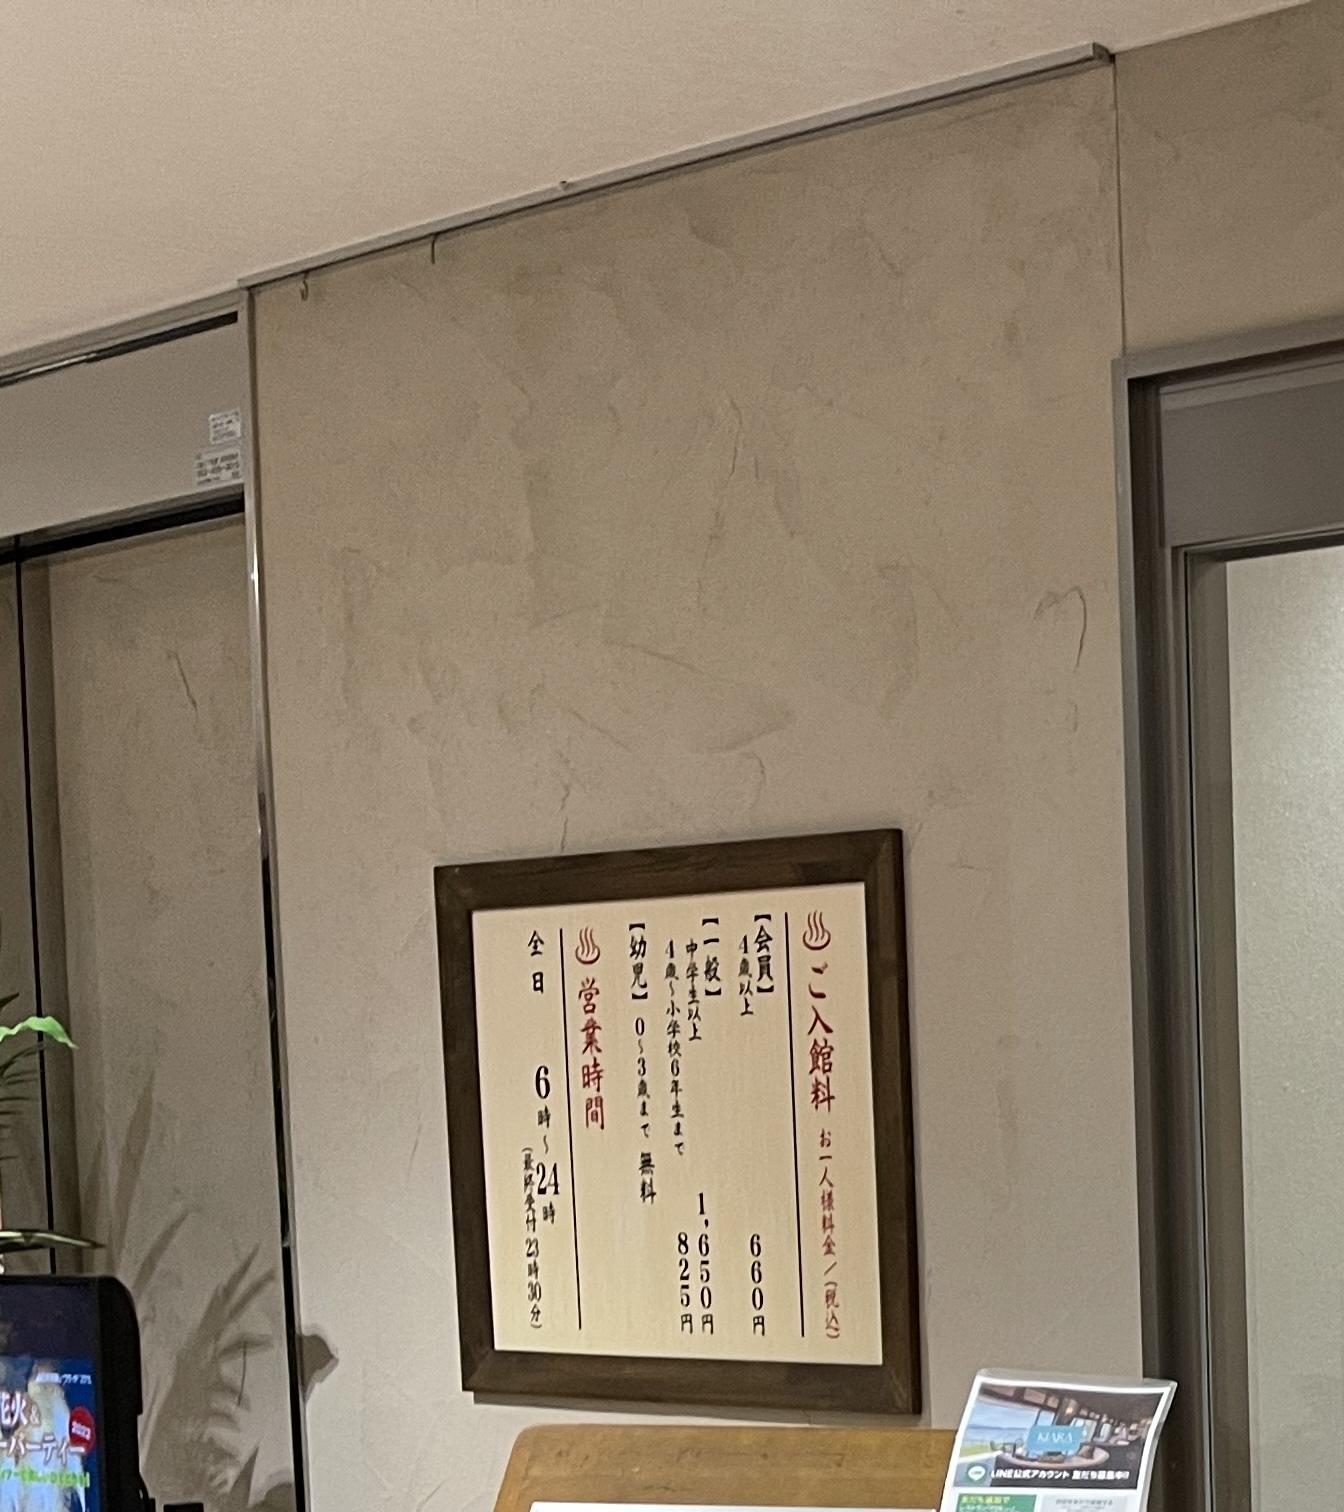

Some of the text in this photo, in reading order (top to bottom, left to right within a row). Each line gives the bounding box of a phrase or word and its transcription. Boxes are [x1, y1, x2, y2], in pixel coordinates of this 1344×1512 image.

[685, 939, 702, 1041] 中学生以上
[807, 964, 836, 1112] ご入館料
[577, 978, 605, 1131] 営業時間
[639, 1152, 656, 1204] 無料
[677, 1233, 693, 1334] 825円
[750, 1235, 766, 1336] 660円
